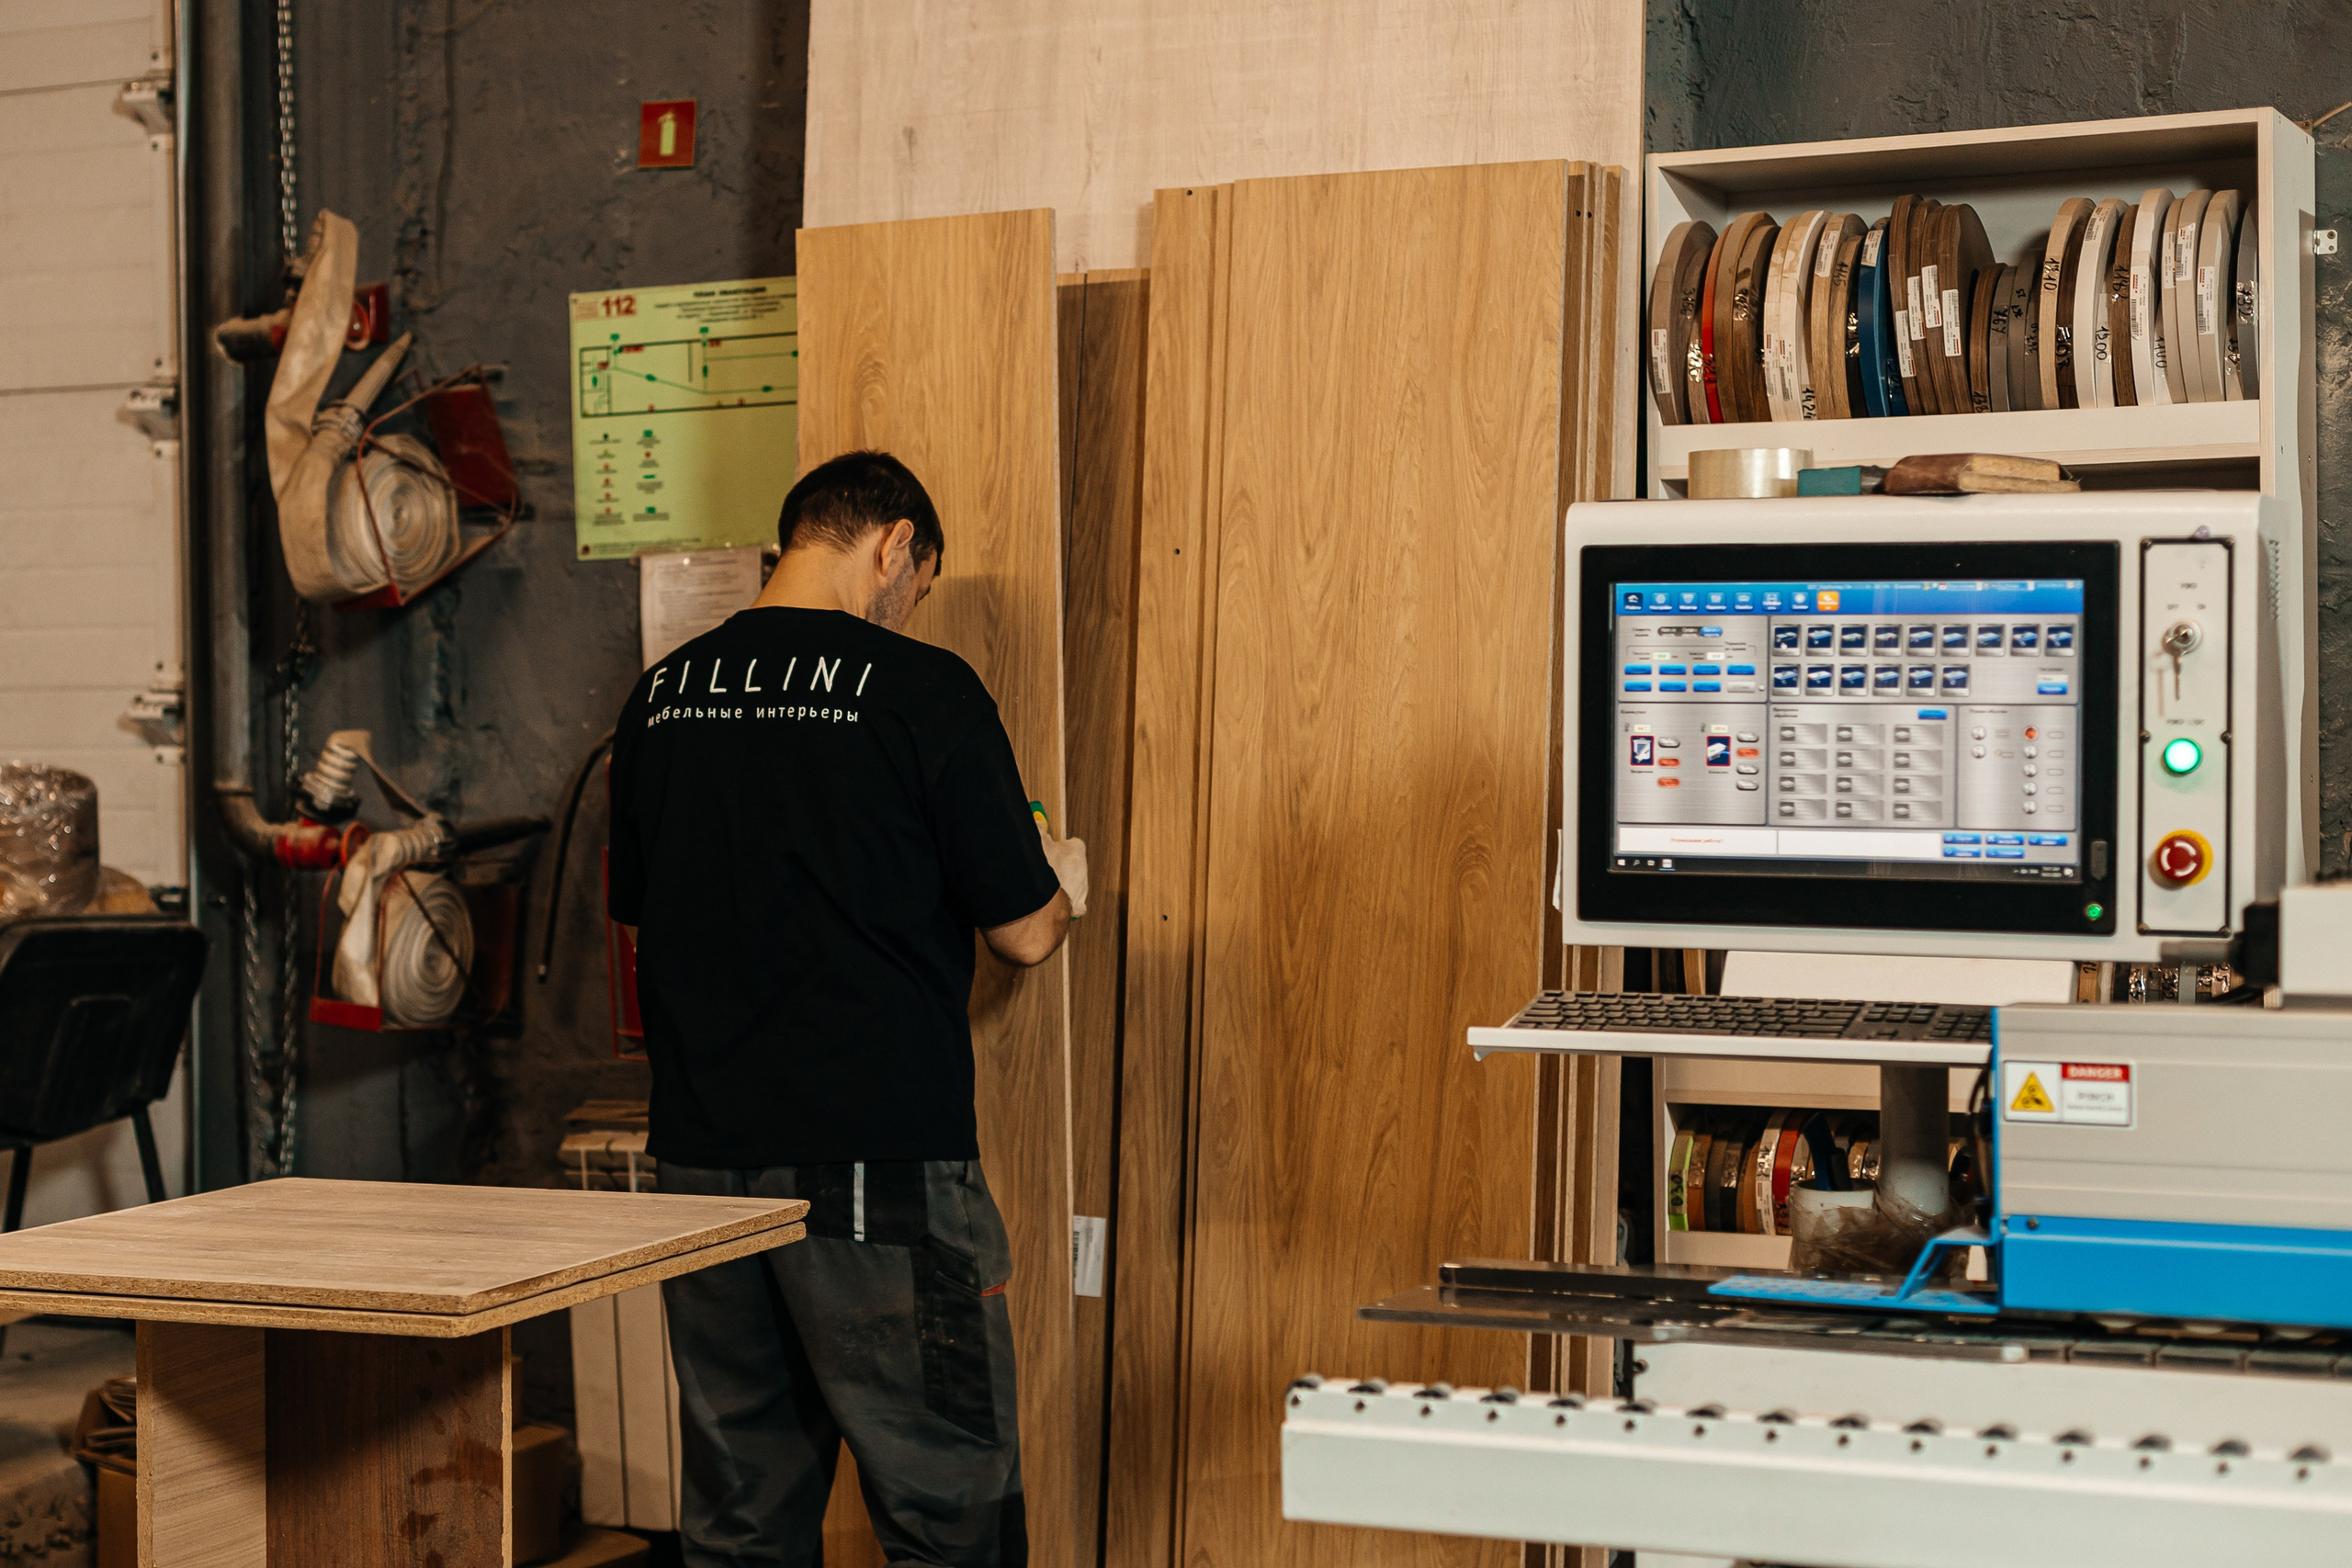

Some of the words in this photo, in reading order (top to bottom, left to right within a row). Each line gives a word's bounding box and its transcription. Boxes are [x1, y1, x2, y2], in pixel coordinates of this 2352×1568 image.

[603, 295, 637, 317] 112
[2096, 326, 2109, 360] 1200
[649, 656, 872, 703] FILLINI
[647, 705, 743, 728] мебельные
[756, 705, 858, 723] интерьеры
[2070, 1066, 2122, 1078] DANGER
